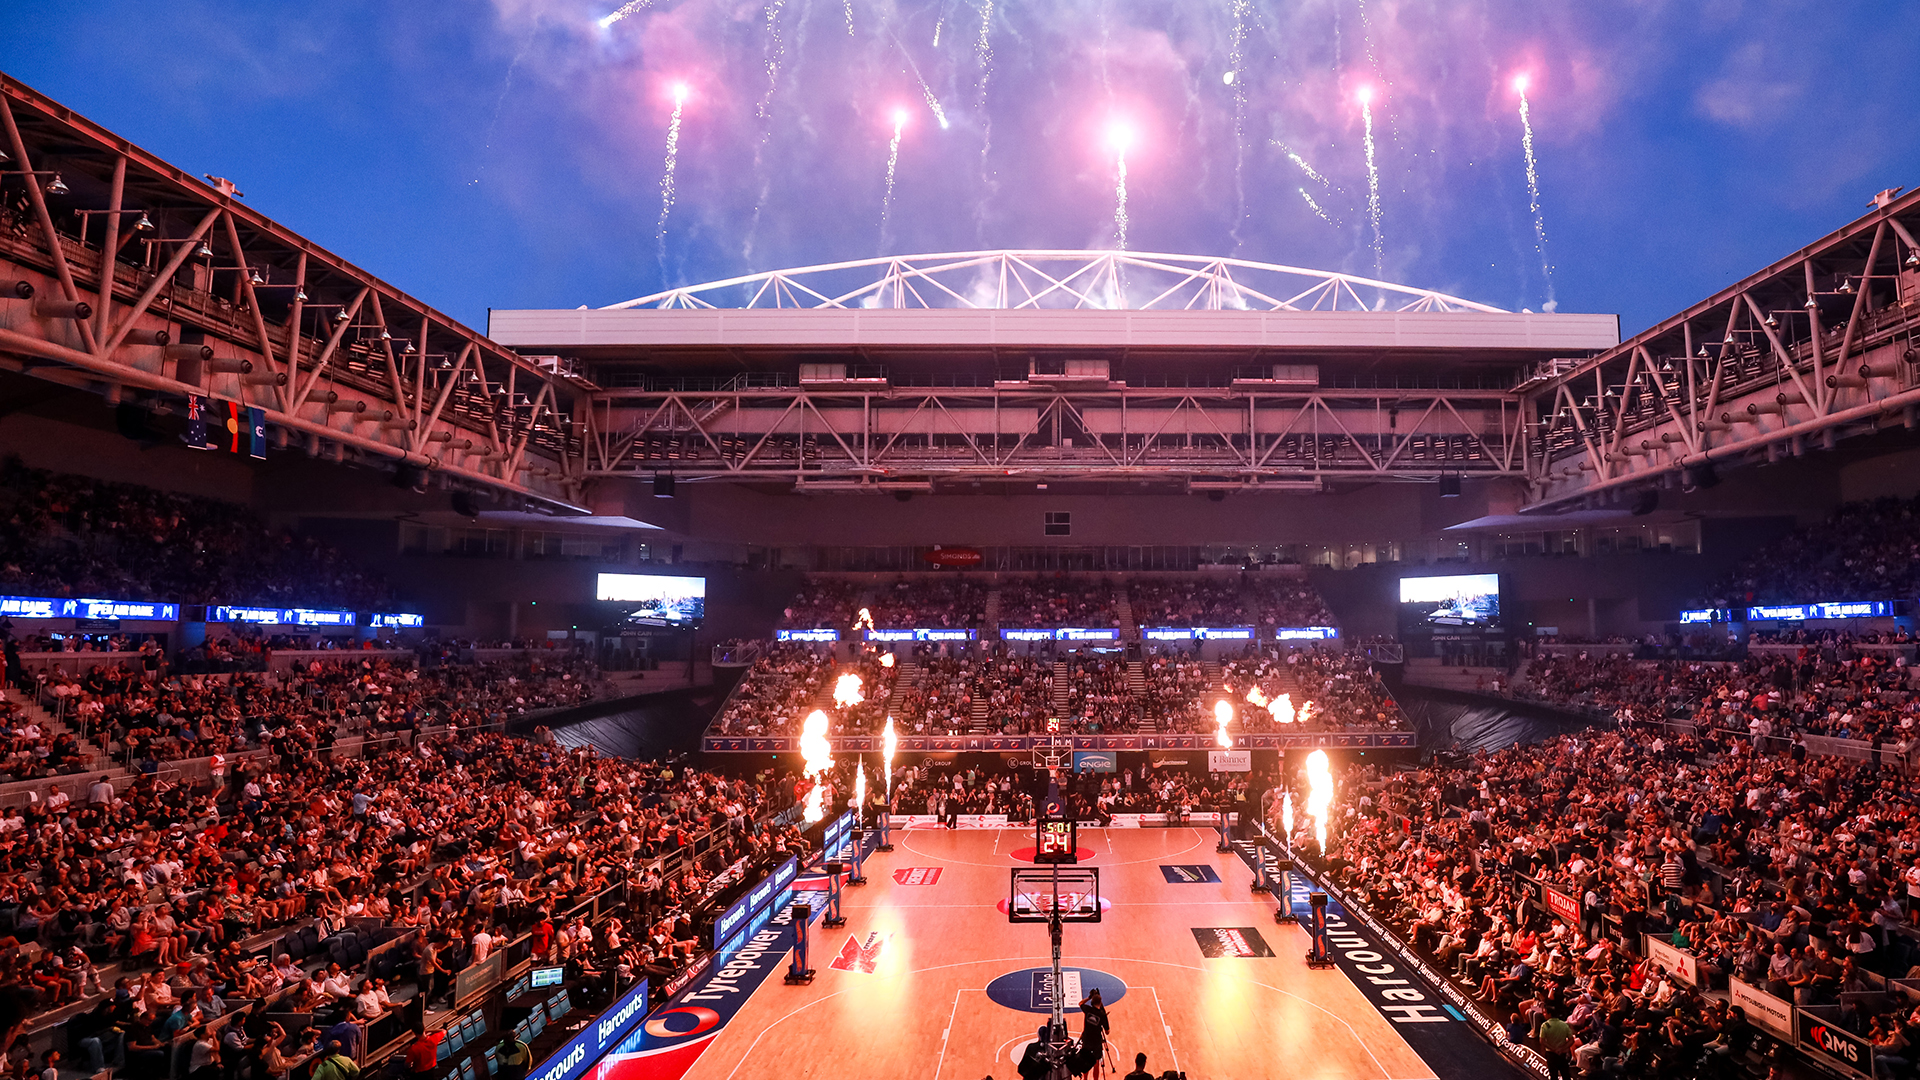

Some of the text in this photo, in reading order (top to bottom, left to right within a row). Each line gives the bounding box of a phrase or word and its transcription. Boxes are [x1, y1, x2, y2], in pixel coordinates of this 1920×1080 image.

[1047, 822, 1071, 833] 5:01
[1044, 834, 1067, 853] 24
[749, 882, 771, 909] Harcourts
[1549, 892, 1576, 914] TROJAN
[720, 904, 745, 935] Harcourts
[1367, 917, 1384, 938] Harcourts
[1383, 931, 1401, 951] Harcourts
[680, 929, 783, 1004] Tyrepower
[1307, 913, 1450, 1023] Harcourts
[1400, 947, 1420, 968] Harcourts
[1420, 962, 1442, 986] Harcourts
[1440, 981, 1466, 1007] Harcourts
[1741, 994, 1787, 1021] MITSUBISHI MOTORS
[598, 993, 643, 1043] Harcourts
[1464, 1002, 1491, 1030] Harcourts
[1491, 1026, 1526, 1058] Harcourts
[1824, 1030, 1858, 1062] QMS
